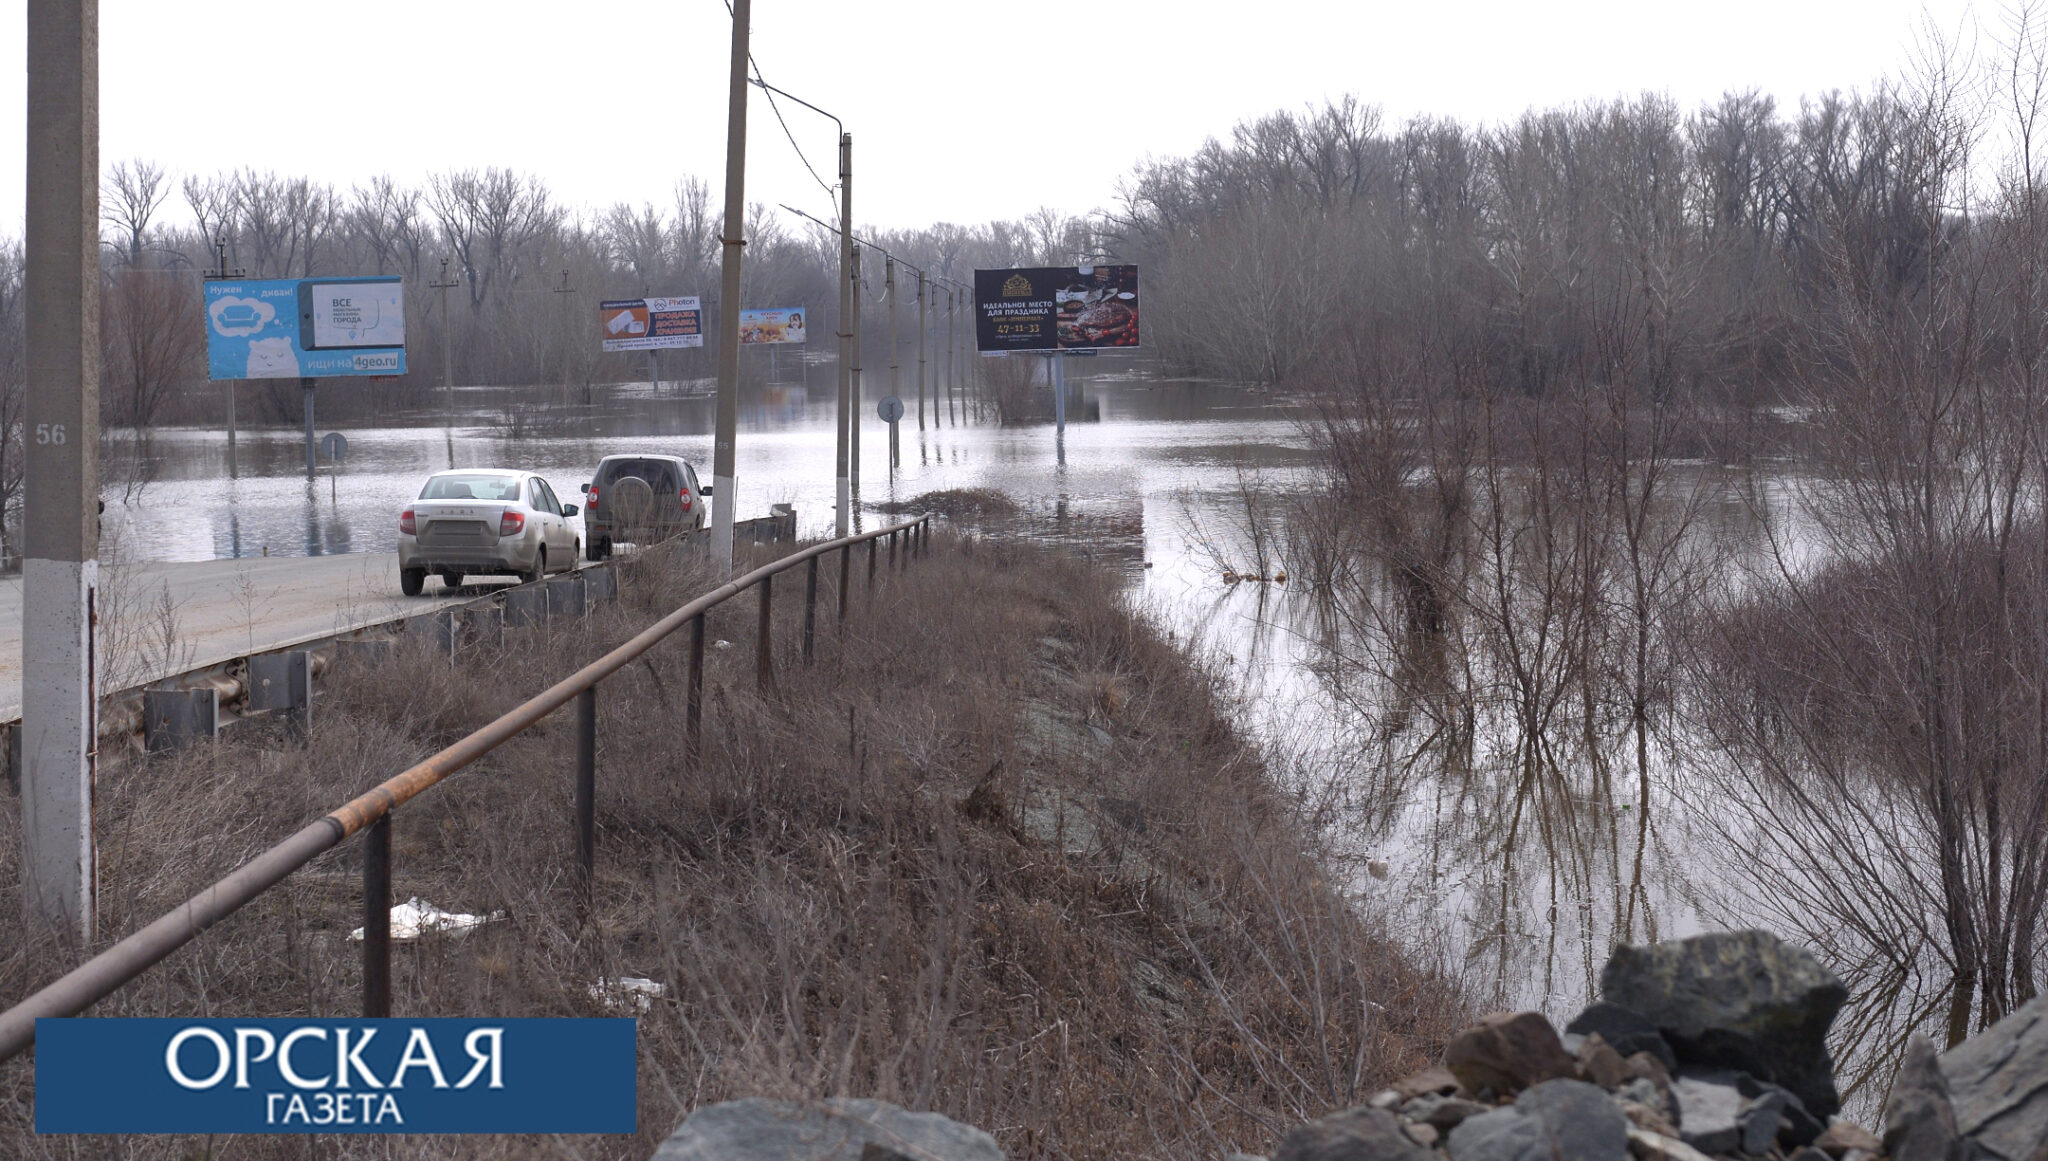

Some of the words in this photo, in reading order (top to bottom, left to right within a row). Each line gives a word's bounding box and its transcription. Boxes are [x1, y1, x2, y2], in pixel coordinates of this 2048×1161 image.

[209, 285, 243, 295] Нужен
[332, 298, 352, 307] ВСЕ
[668, 299, 695, 307] Photon
[983, 302, 1026, 310] ИДЕАЛЬНОЕ
[654, 311, 696, 319] ПРОДАЖА
[987, 309, 1003, 317] ДЛЯ
[1004, 308, 1049, 316] ПРАЗДНИКА
[333, 316, 362, 324] ГОРОДА
[655, 319, 697, 328] ДОСТАВКА
[996, 323, 1041, 334] 47-11-33
[307, 360, 336, 370] ищи
[337, 359, 352, 368] на
[353, 355, 397, 370] 4geo.ru
[35, 423, 66, 446] 56
